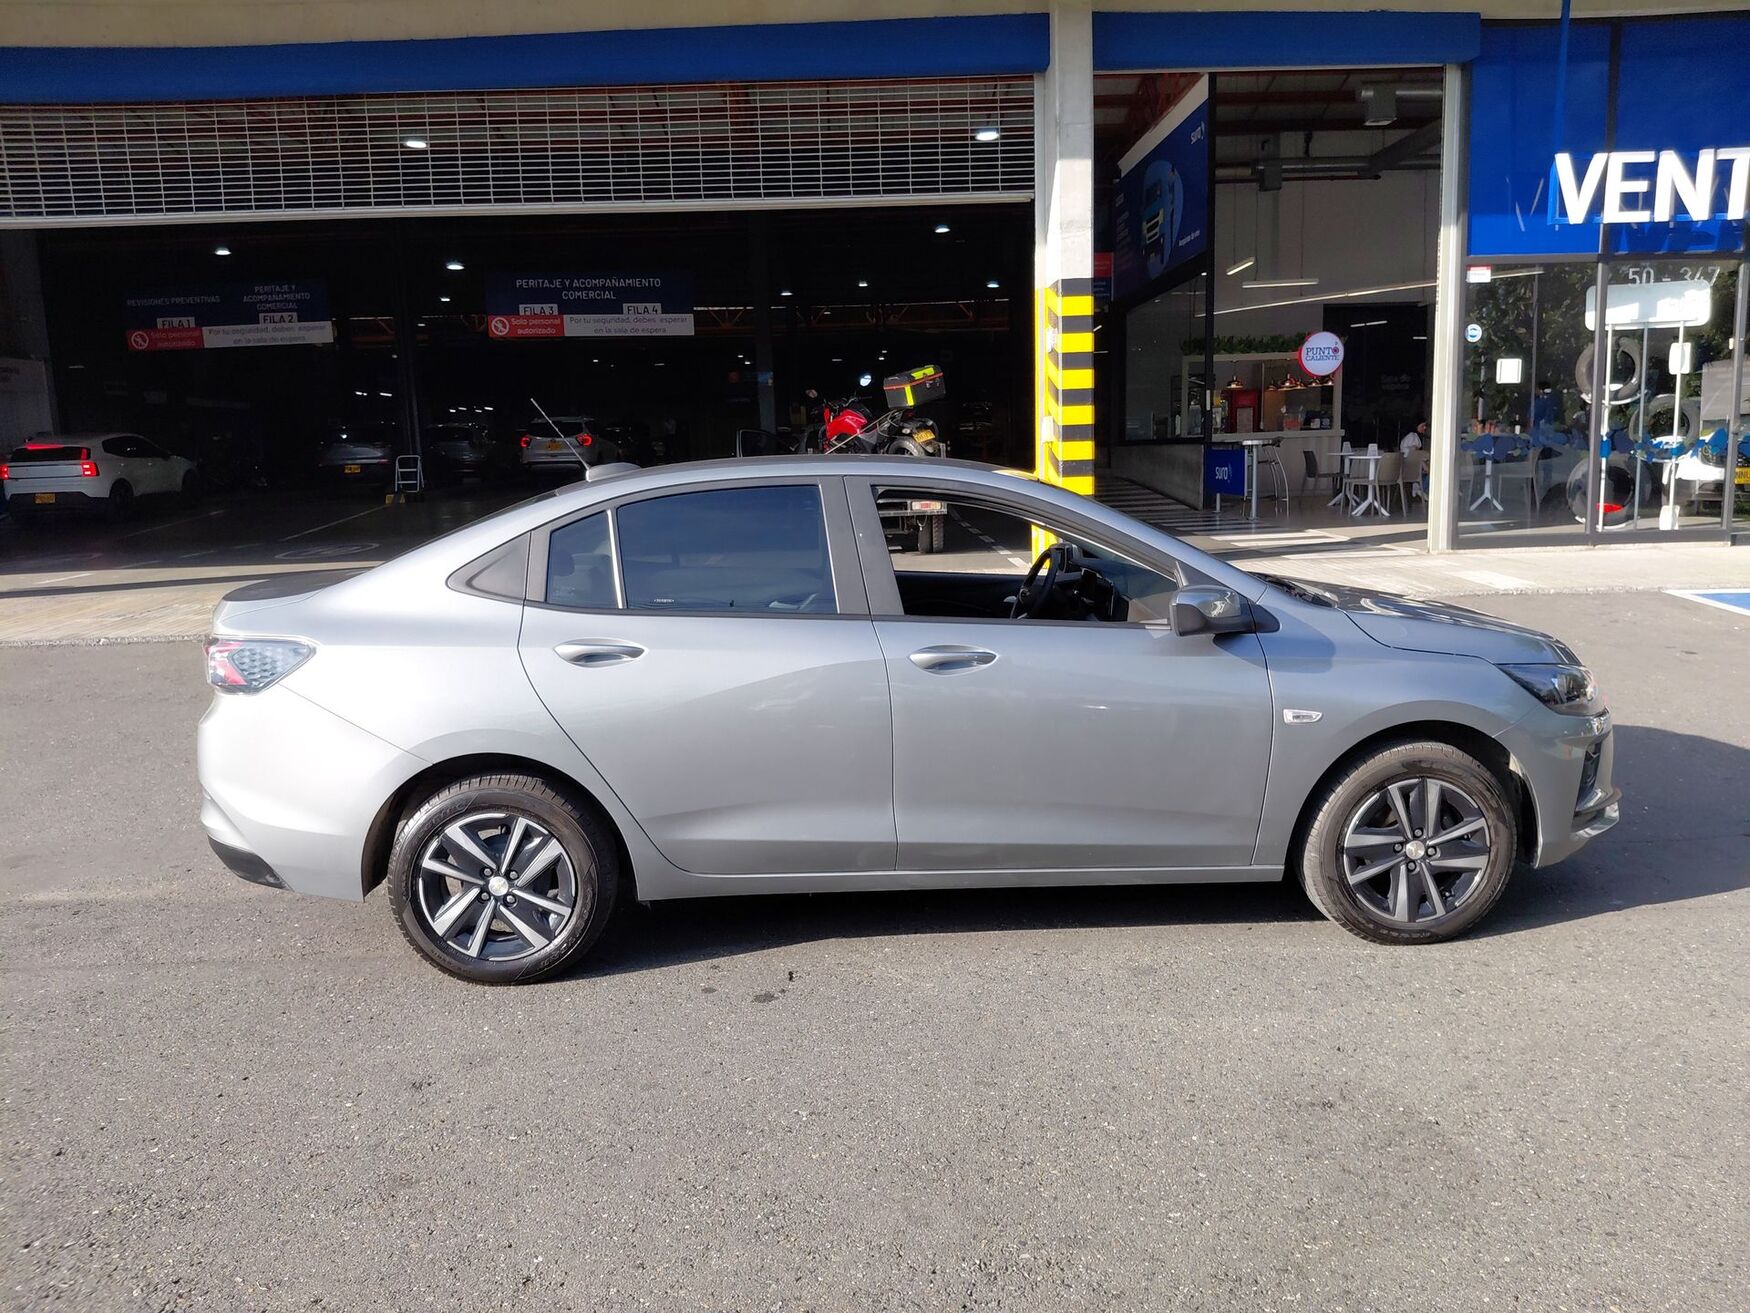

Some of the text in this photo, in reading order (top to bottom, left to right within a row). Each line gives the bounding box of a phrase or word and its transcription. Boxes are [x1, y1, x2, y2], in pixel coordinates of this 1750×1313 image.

[1554, 147, 1750, 224] VENT
[1628, 267, 1655, 285] 50
[516, 276, 661, 289] PERITAJE Y ACOMPAÑAMIENTO
[254, 284, 290, 293] PERITAJE
[562, 290, 617, 300] COMERCIAL
[257, 302, 298, 310] COMERCIAL
[523, 306, 554, 316] FILA 3
[627, 305, 658, 315] FILA 4
[263, 314, 294, 323] FILA 2
[529, 317, 561, 326] personal
[660, 317, 688, 325] esperar
[162, 320, 184, 328] FILA
[1306, 346, 1340, 356] PUNTO
